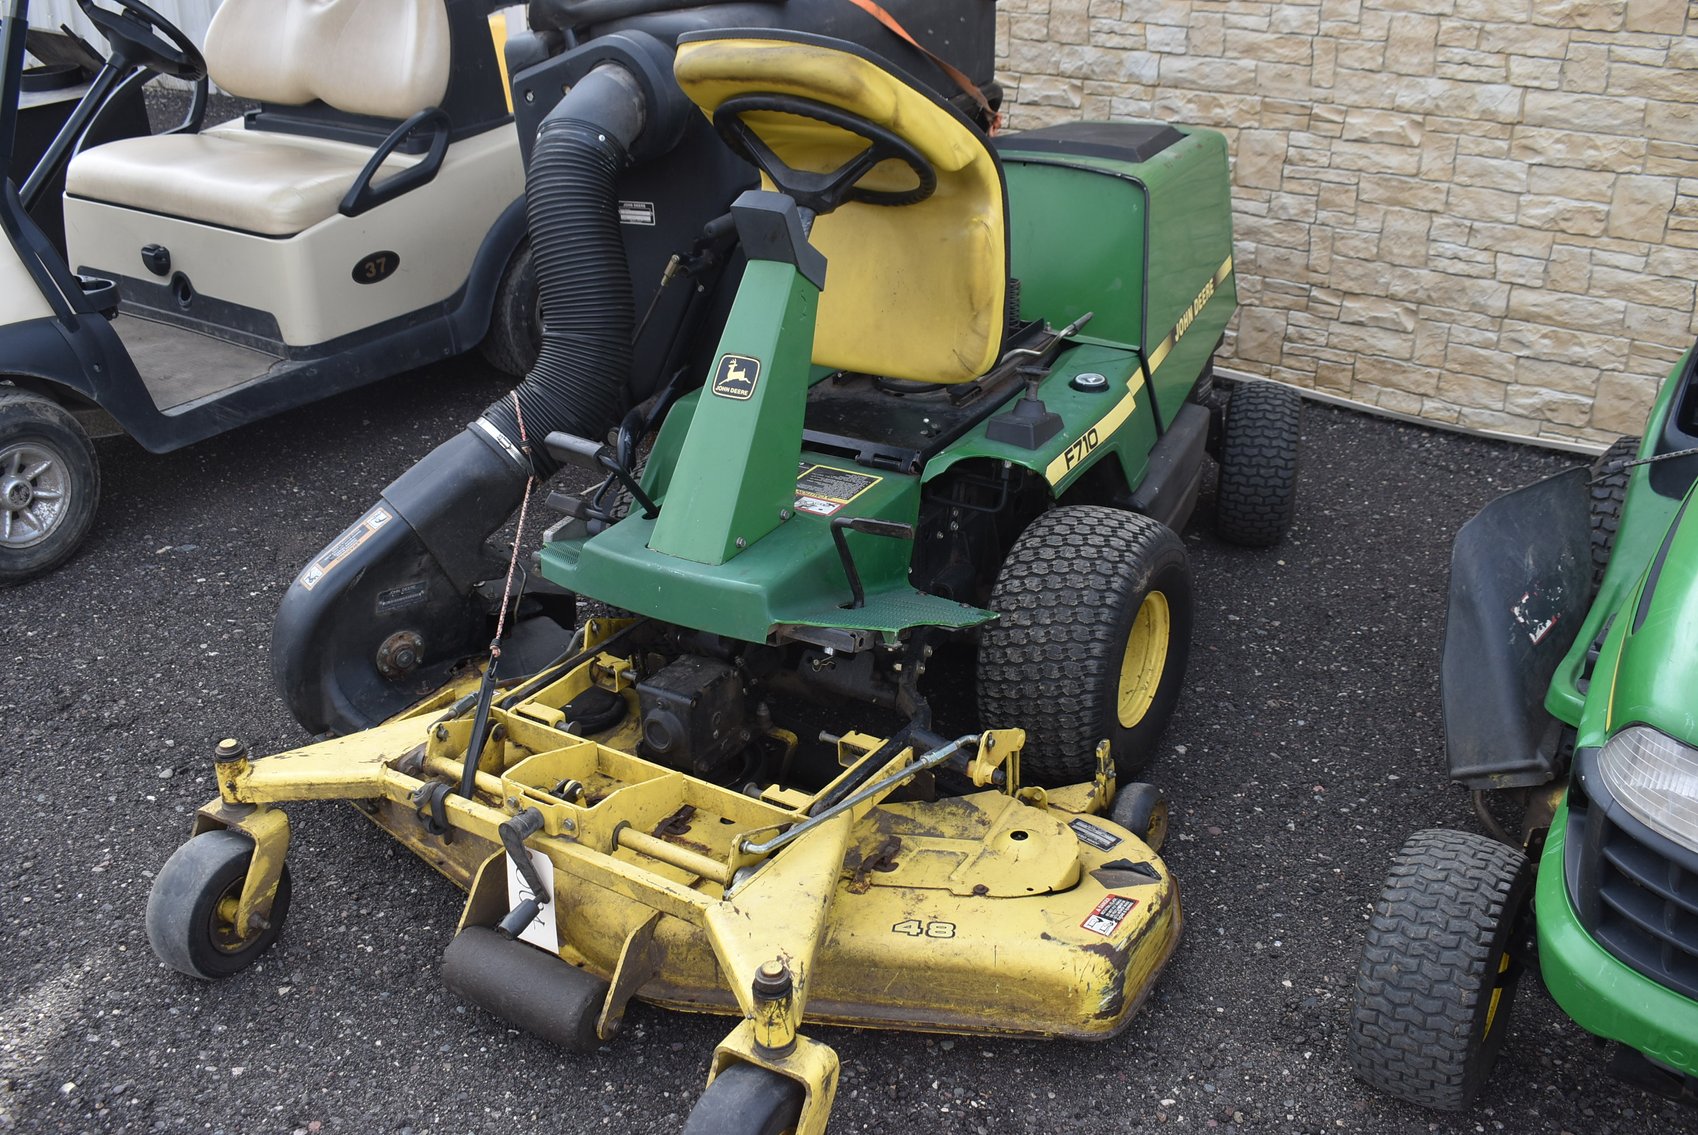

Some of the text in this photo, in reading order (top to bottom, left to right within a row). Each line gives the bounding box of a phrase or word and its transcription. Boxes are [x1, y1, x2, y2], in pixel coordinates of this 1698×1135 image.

[364, 256, 386, 278] 37
[1175, 277, 1215, 342] JOHN DEERE
[715, 385, 749, 396] JOHN DEERE
[1064, 428, 1099, 471] F710
[892, 919, 957, 939] 48
